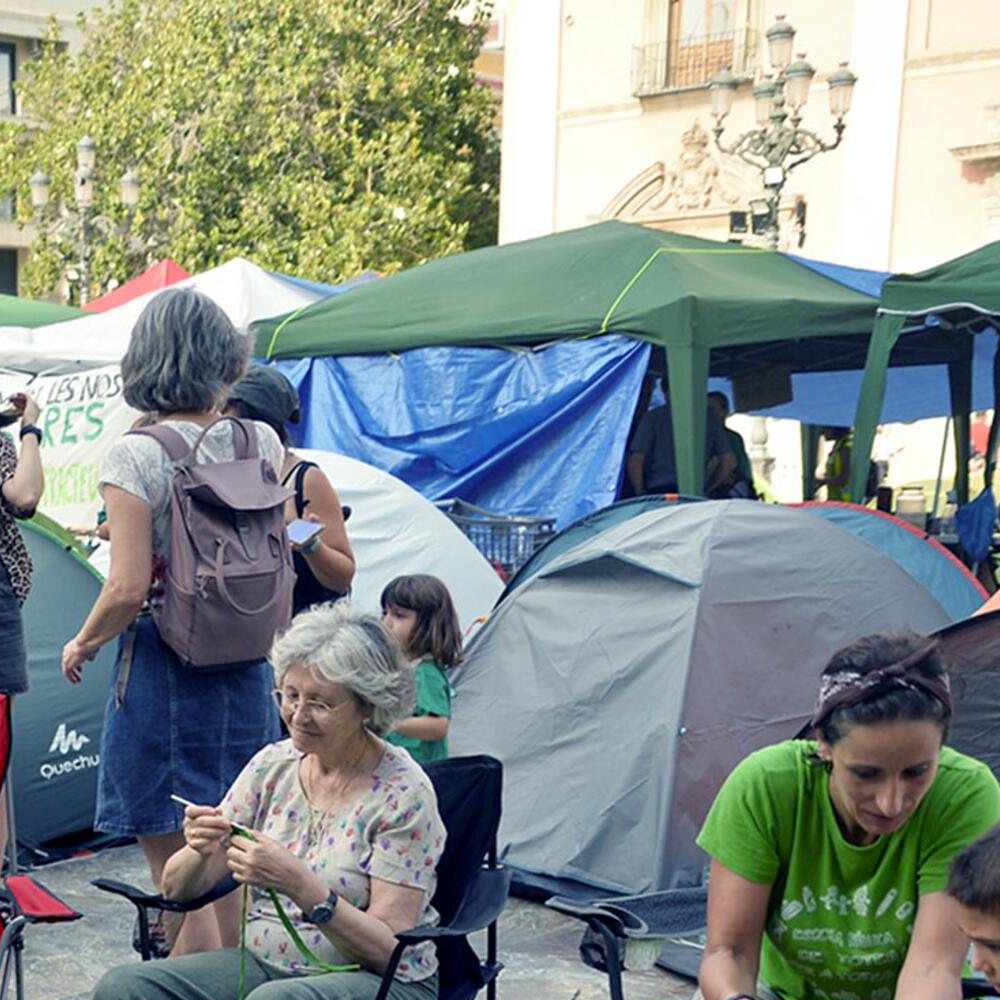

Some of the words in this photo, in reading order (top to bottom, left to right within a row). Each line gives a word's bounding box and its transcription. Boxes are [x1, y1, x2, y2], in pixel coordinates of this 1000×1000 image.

[46, 376, 79, 405] LES
[39, 402, 106, 449] RES
[40, 755, 100, 779] Quechu
